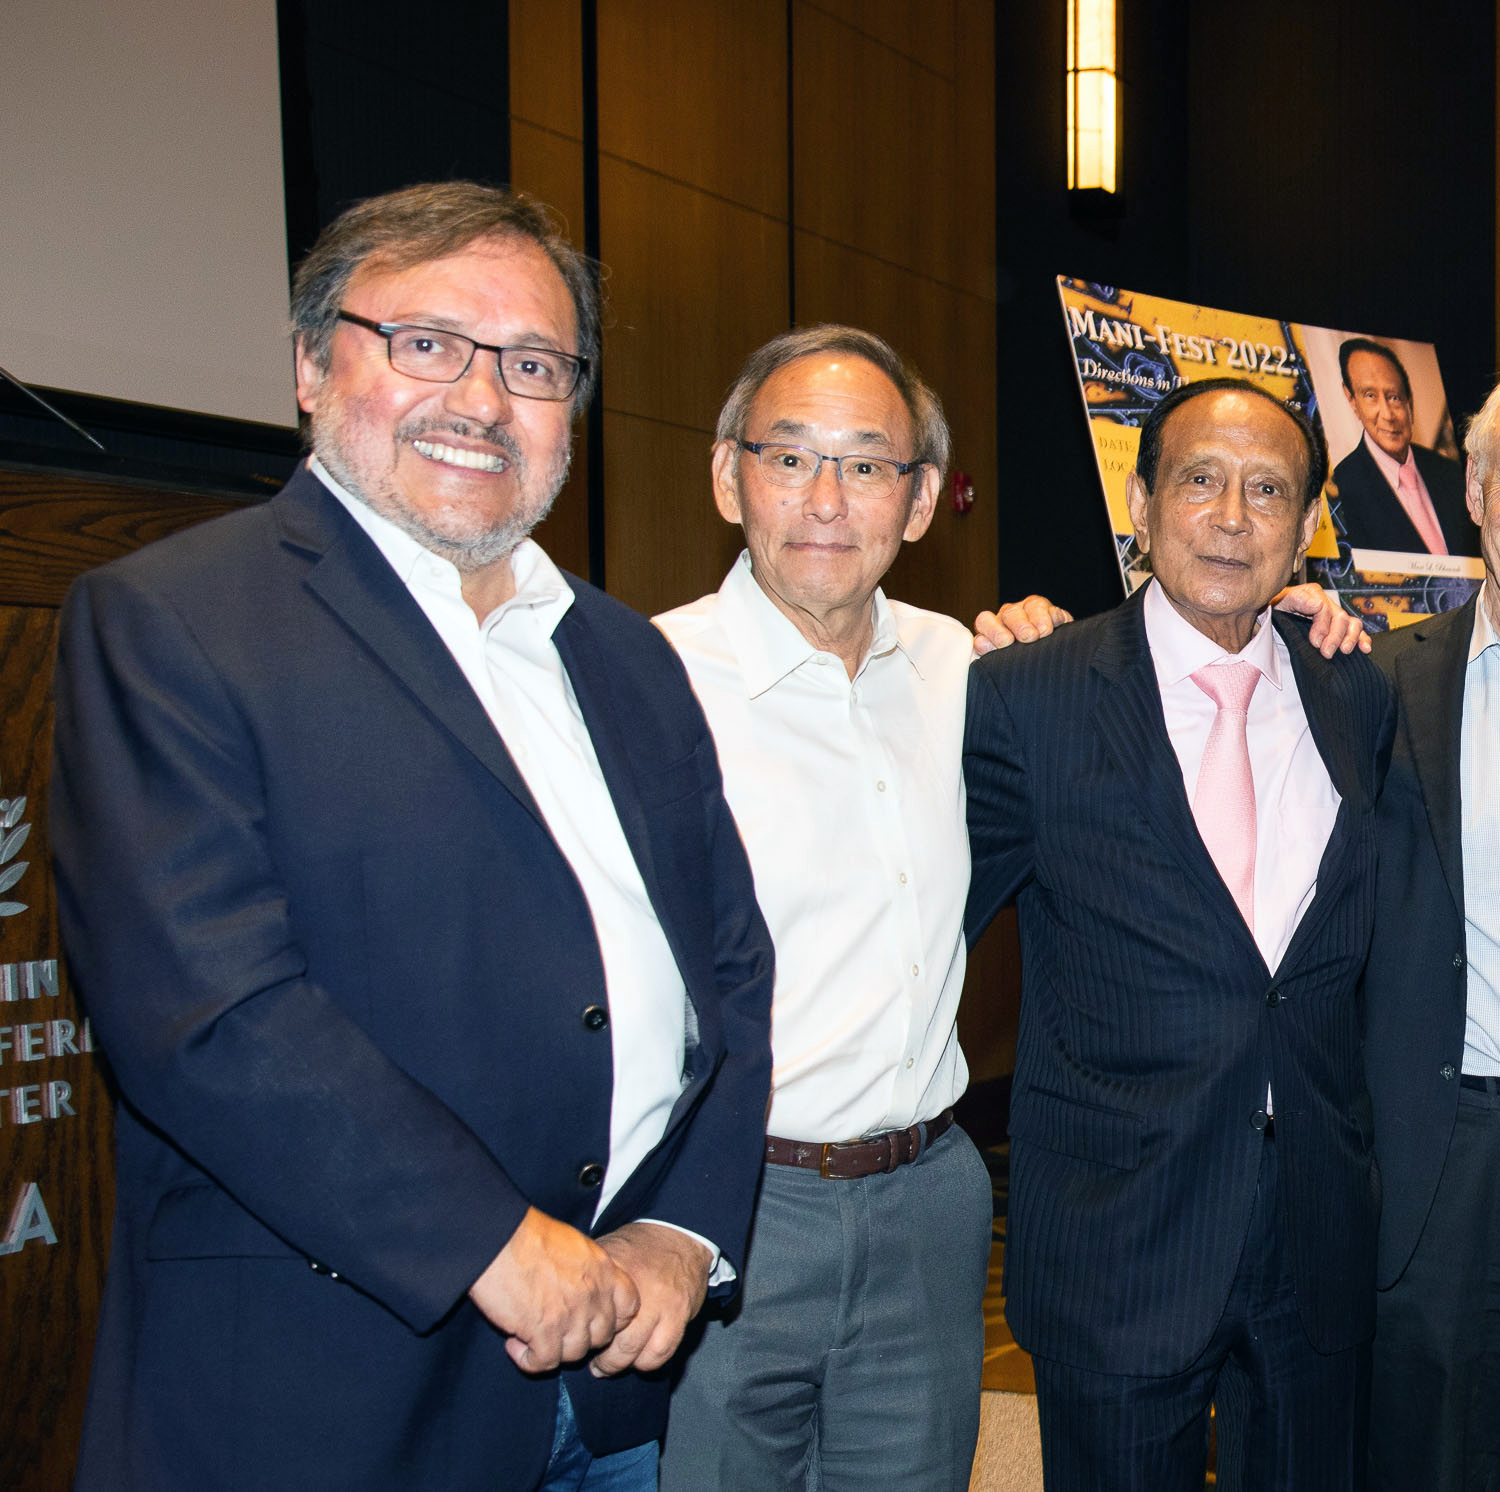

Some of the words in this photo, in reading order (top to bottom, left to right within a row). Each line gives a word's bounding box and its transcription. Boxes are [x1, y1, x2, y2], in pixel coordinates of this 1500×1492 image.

[1220, 336, 1300, 377] 2022:
[1083, 359, 1155, 389] Directions
[1155, 379, 1171, 392] in
